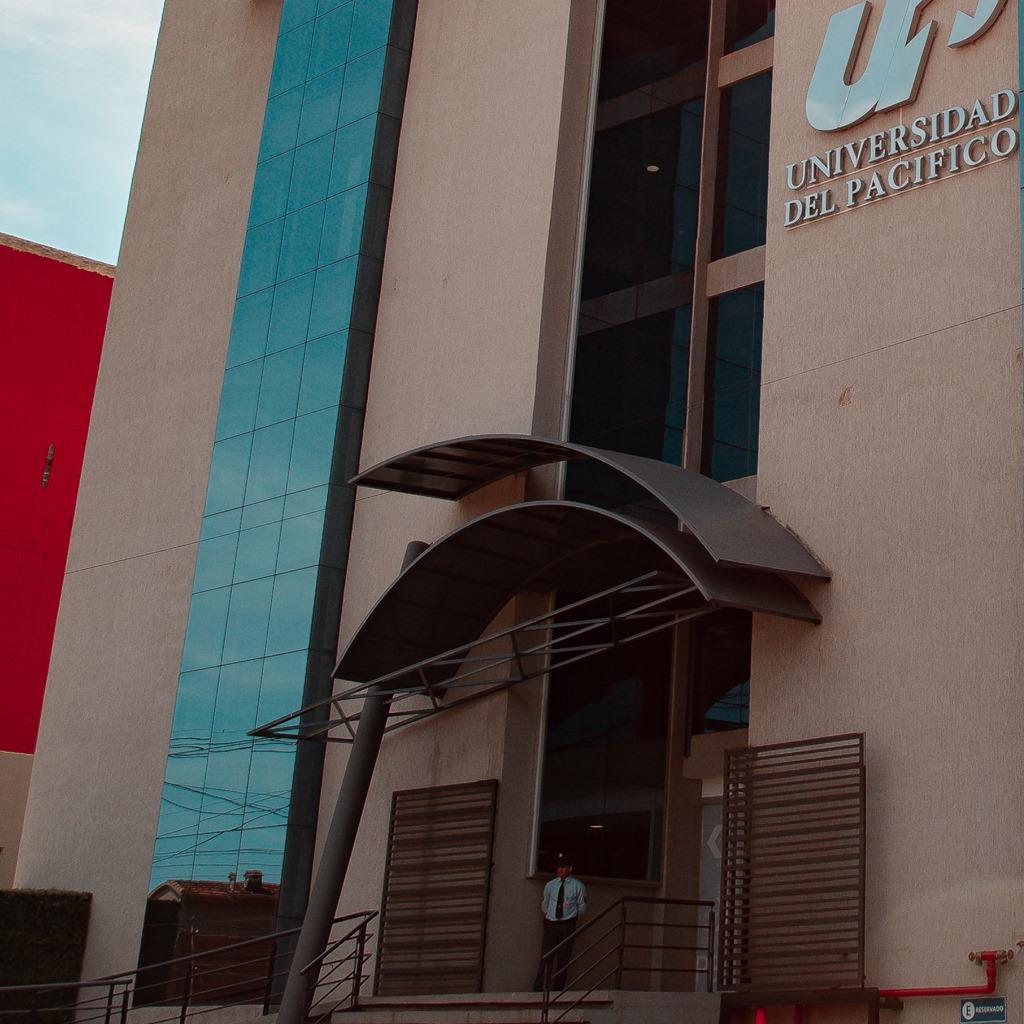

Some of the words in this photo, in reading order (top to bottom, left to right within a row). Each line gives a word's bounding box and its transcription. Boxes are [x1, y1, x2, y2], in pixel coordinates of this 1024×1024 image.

[783, 190, 837, 228] DEL
[846, 127, 1019, 207] PACIFICO
[786, 88, 1018, 191] UNIVERSIDAD
[975, 1005, 1004, 1013] RESERVADO
